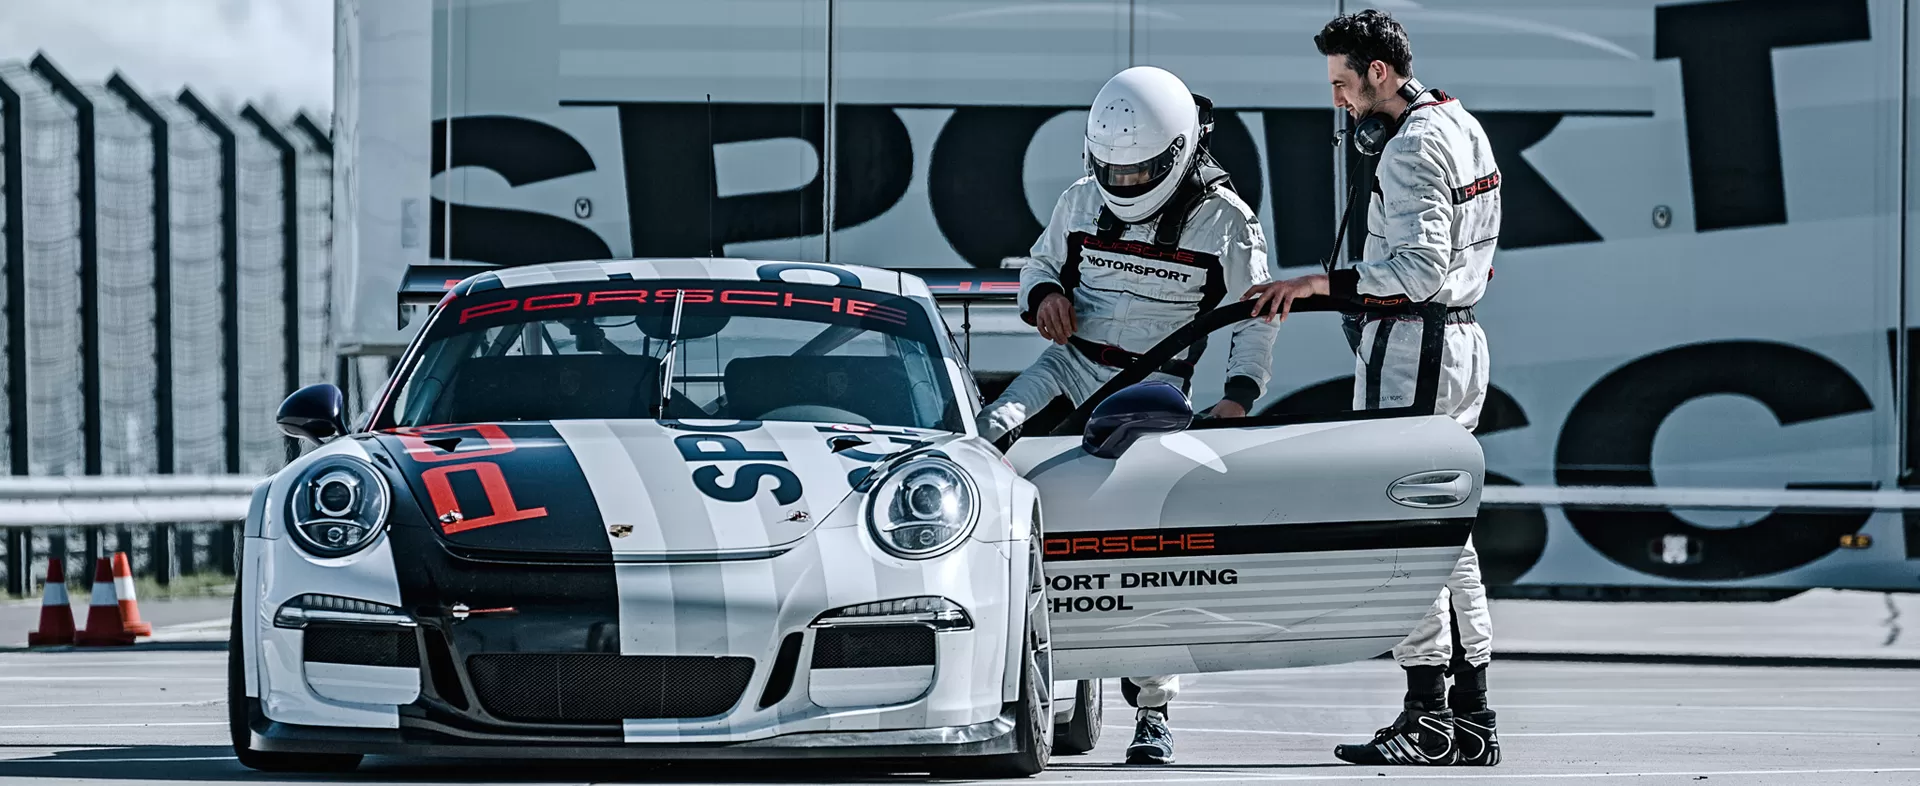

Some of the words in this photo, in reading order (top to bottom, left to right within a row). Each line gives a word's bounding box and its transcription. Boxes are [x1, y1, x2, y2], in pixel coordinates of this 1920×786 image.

[1087, 255, 1191, 283] MOTORSPORT
[459, 288, 907, 325] PORSCHE
[1121, 569, 1238, 588] DRIVING
